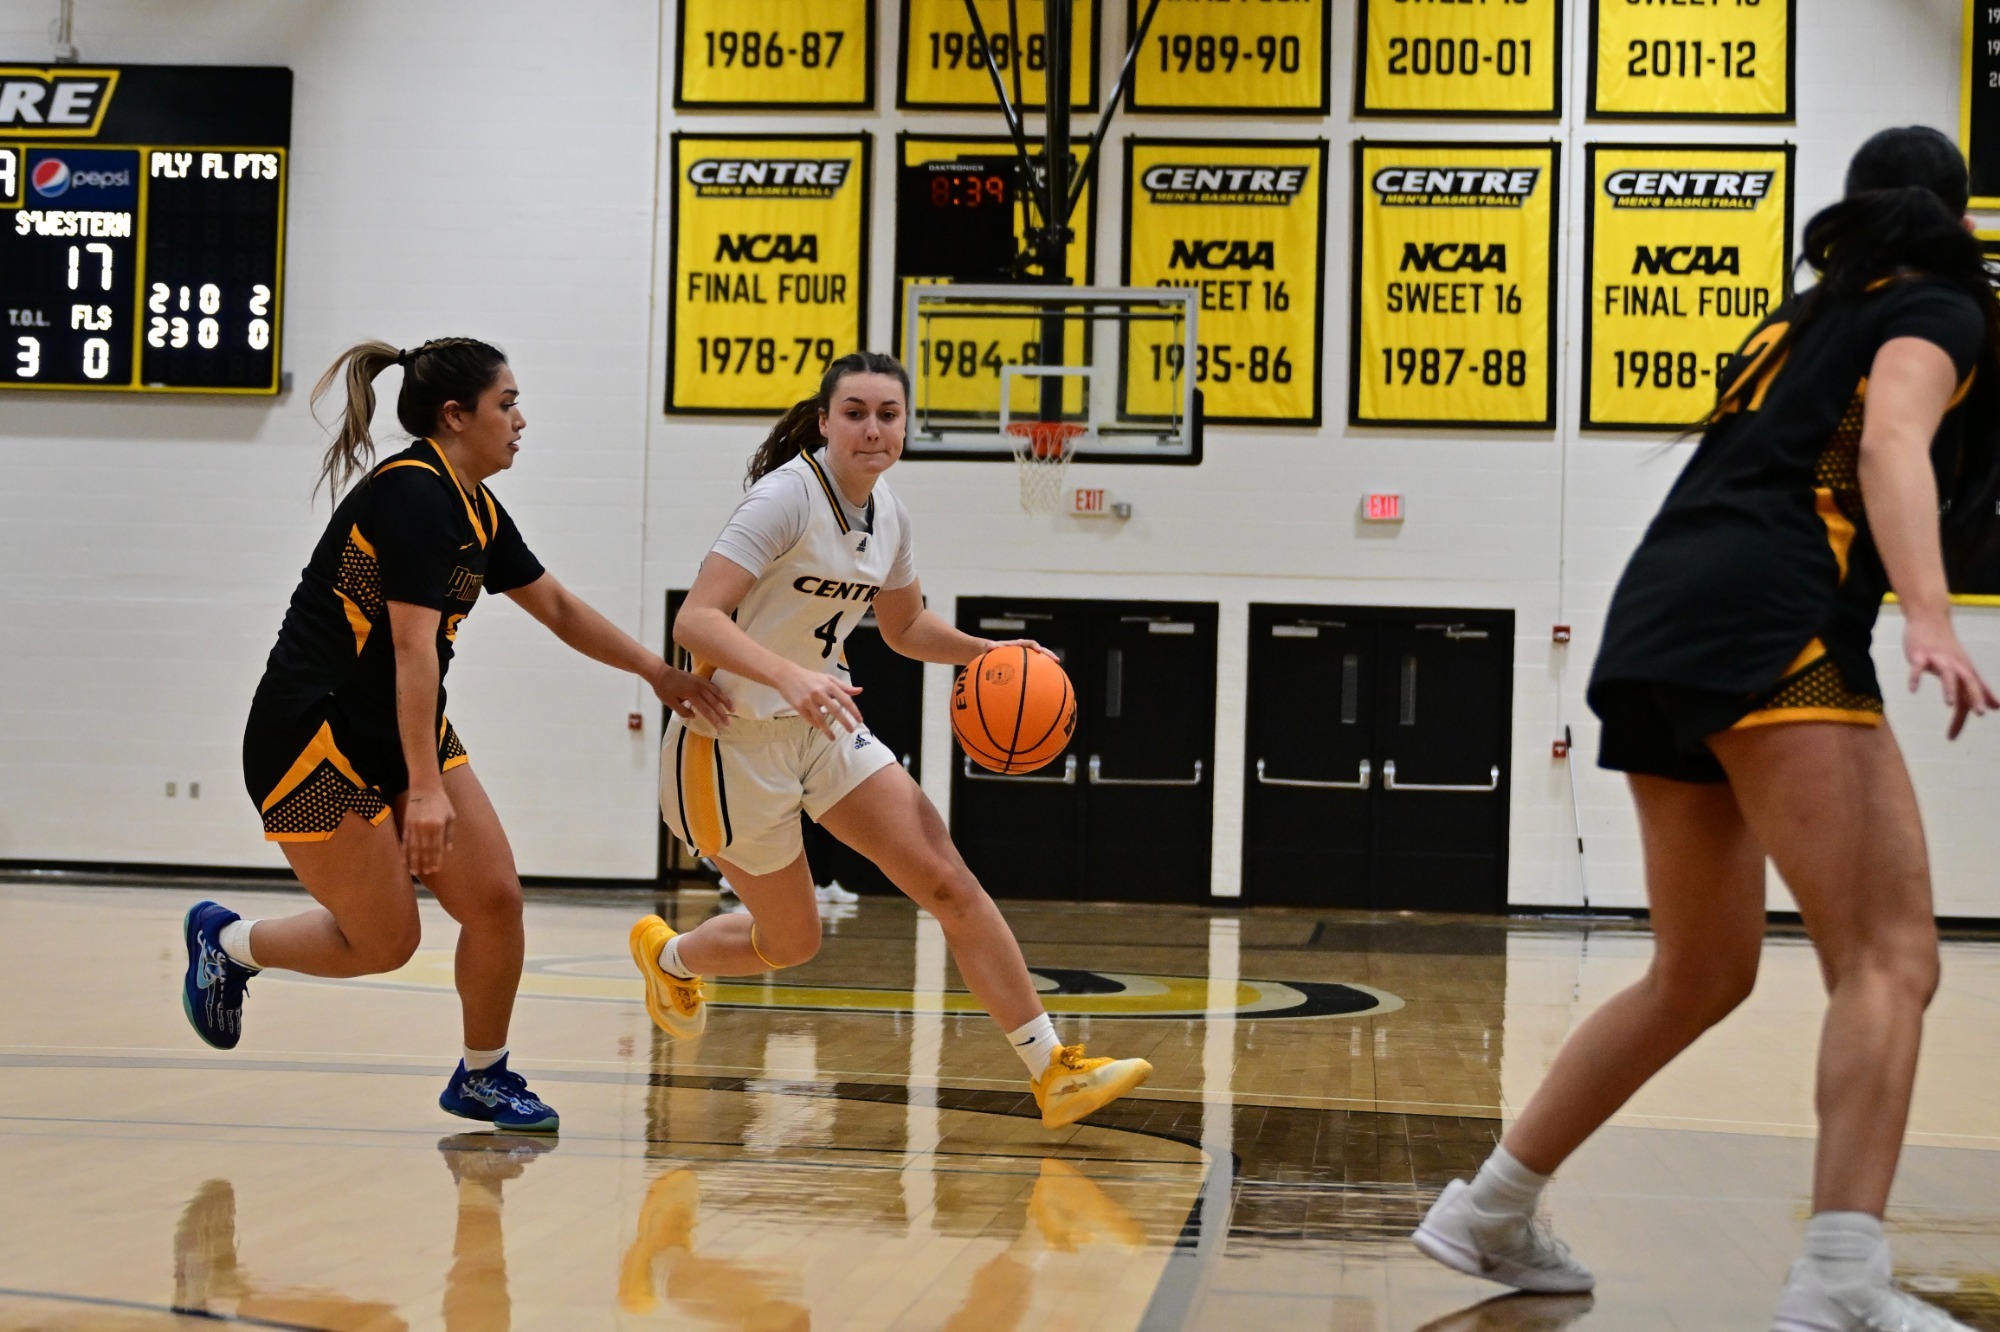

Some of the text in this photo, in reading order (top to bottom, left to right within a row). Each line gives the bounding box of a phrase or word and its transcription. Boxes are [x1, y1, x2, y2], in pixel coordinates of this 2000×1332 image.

[705, 31, 845, 69] 1986-87
[929, 31, 1046, 72] 1988-8
[1157, 34, 1300, 75] 1989-90
[1388, 37, 1531, 77] 2000-01
[1628, 39, 1757, 79] 2011-12
[71, 168, 130, 190] pepsi
[151, 152, 277, 180] PLY FL PTS
[690, 161, 847, 185] CENTRE
[928, 164, 984, 172] DAKTRONICS
[1144, 167, 1302, 192] CENTRE
[1375, 169, 1534, 194] CENTRE
[701, 185, 832, 197] MEN'S BASKETBALL
[1155, 191, 1288, 205] MEN'S BASKETBALL
[1385, 193, 1520, 207] MEN'S BASKETBALL
[1605, 171, 1773, 198] CENTRE
[1617, 196, 1754, 210] MEN'S BASKETBALL
[714, 233, 818, 264] NCAA
[1168, 239, 1275, 271] NCAA
[1400, 242, 1507, 274] NCAA
[1631, 244, 1740, 276] NCAA
[68, 242, 113, 291] 17
[199, 283, 221, 315] 0
[249, 284, 271, 316] 2
[687, 271, 846, 305] FINAL FOUR
[1156, 278, 1290, 312] EET 16
[1386, 281, 1522, 316] SWEET 16
[1604, 285, 1770, 318] FINAL FOUR
[71, 304, 112, 331] FLS
[148, 316, 270, 350] 23 0 0
[16, 336, 40, 378] 3
[82, 337, 110, 379] 0
[697, 336, 835, 376] 1978-79
[920, 338, 1042, 379] 1984-8
[1381, 346, 1528, 388] 1987-88
[1075, 489, 1104, 511] EXIT
[1370, 495, 1399, 519] EXIT
[793, 575, 880, 603] CENTR
[814, 610, 844, 659] 4
